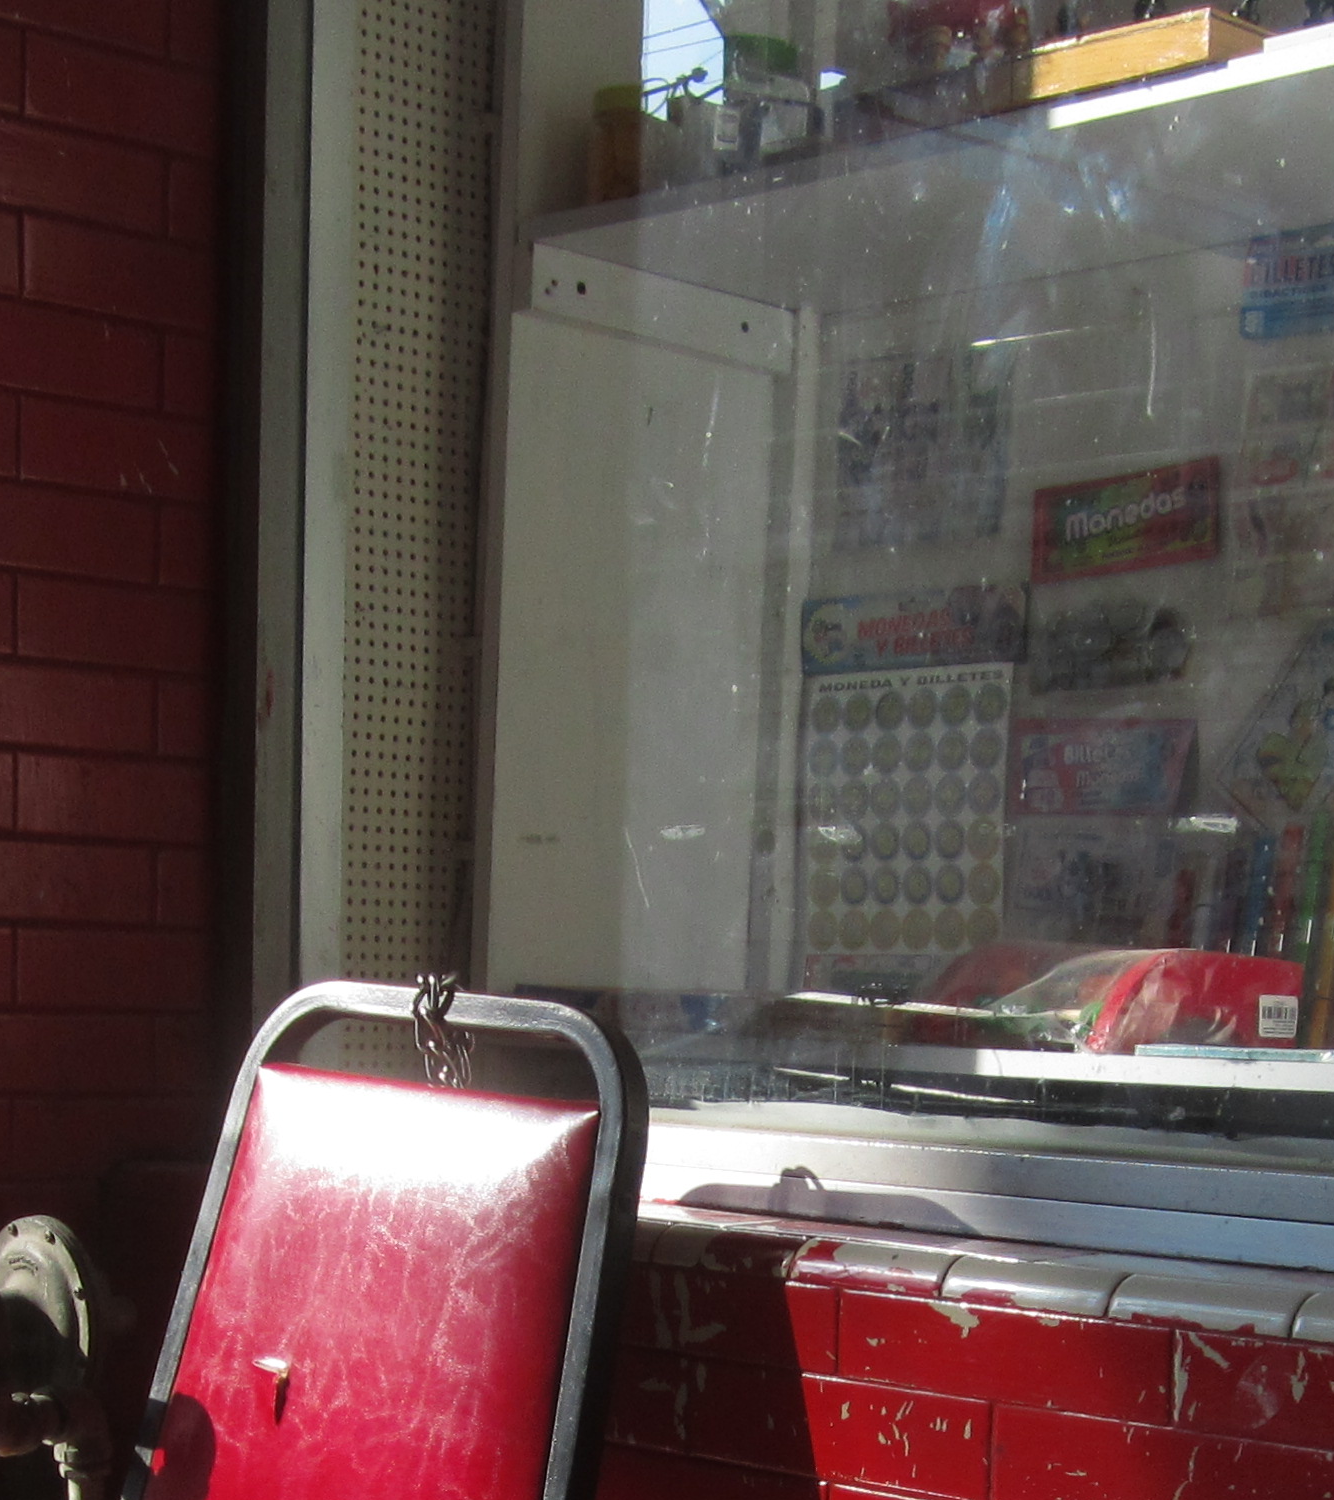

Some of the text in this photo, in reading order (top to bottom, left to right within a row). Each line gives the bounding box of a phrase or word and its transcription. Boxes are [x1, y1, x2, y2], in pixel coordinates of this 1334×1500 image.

[1065, 487, 1187, 542] Monedas
[857, 607, 953, 641] MONEDAS
[819, 670, 1005, 694] MONEDA Y BILLETES
